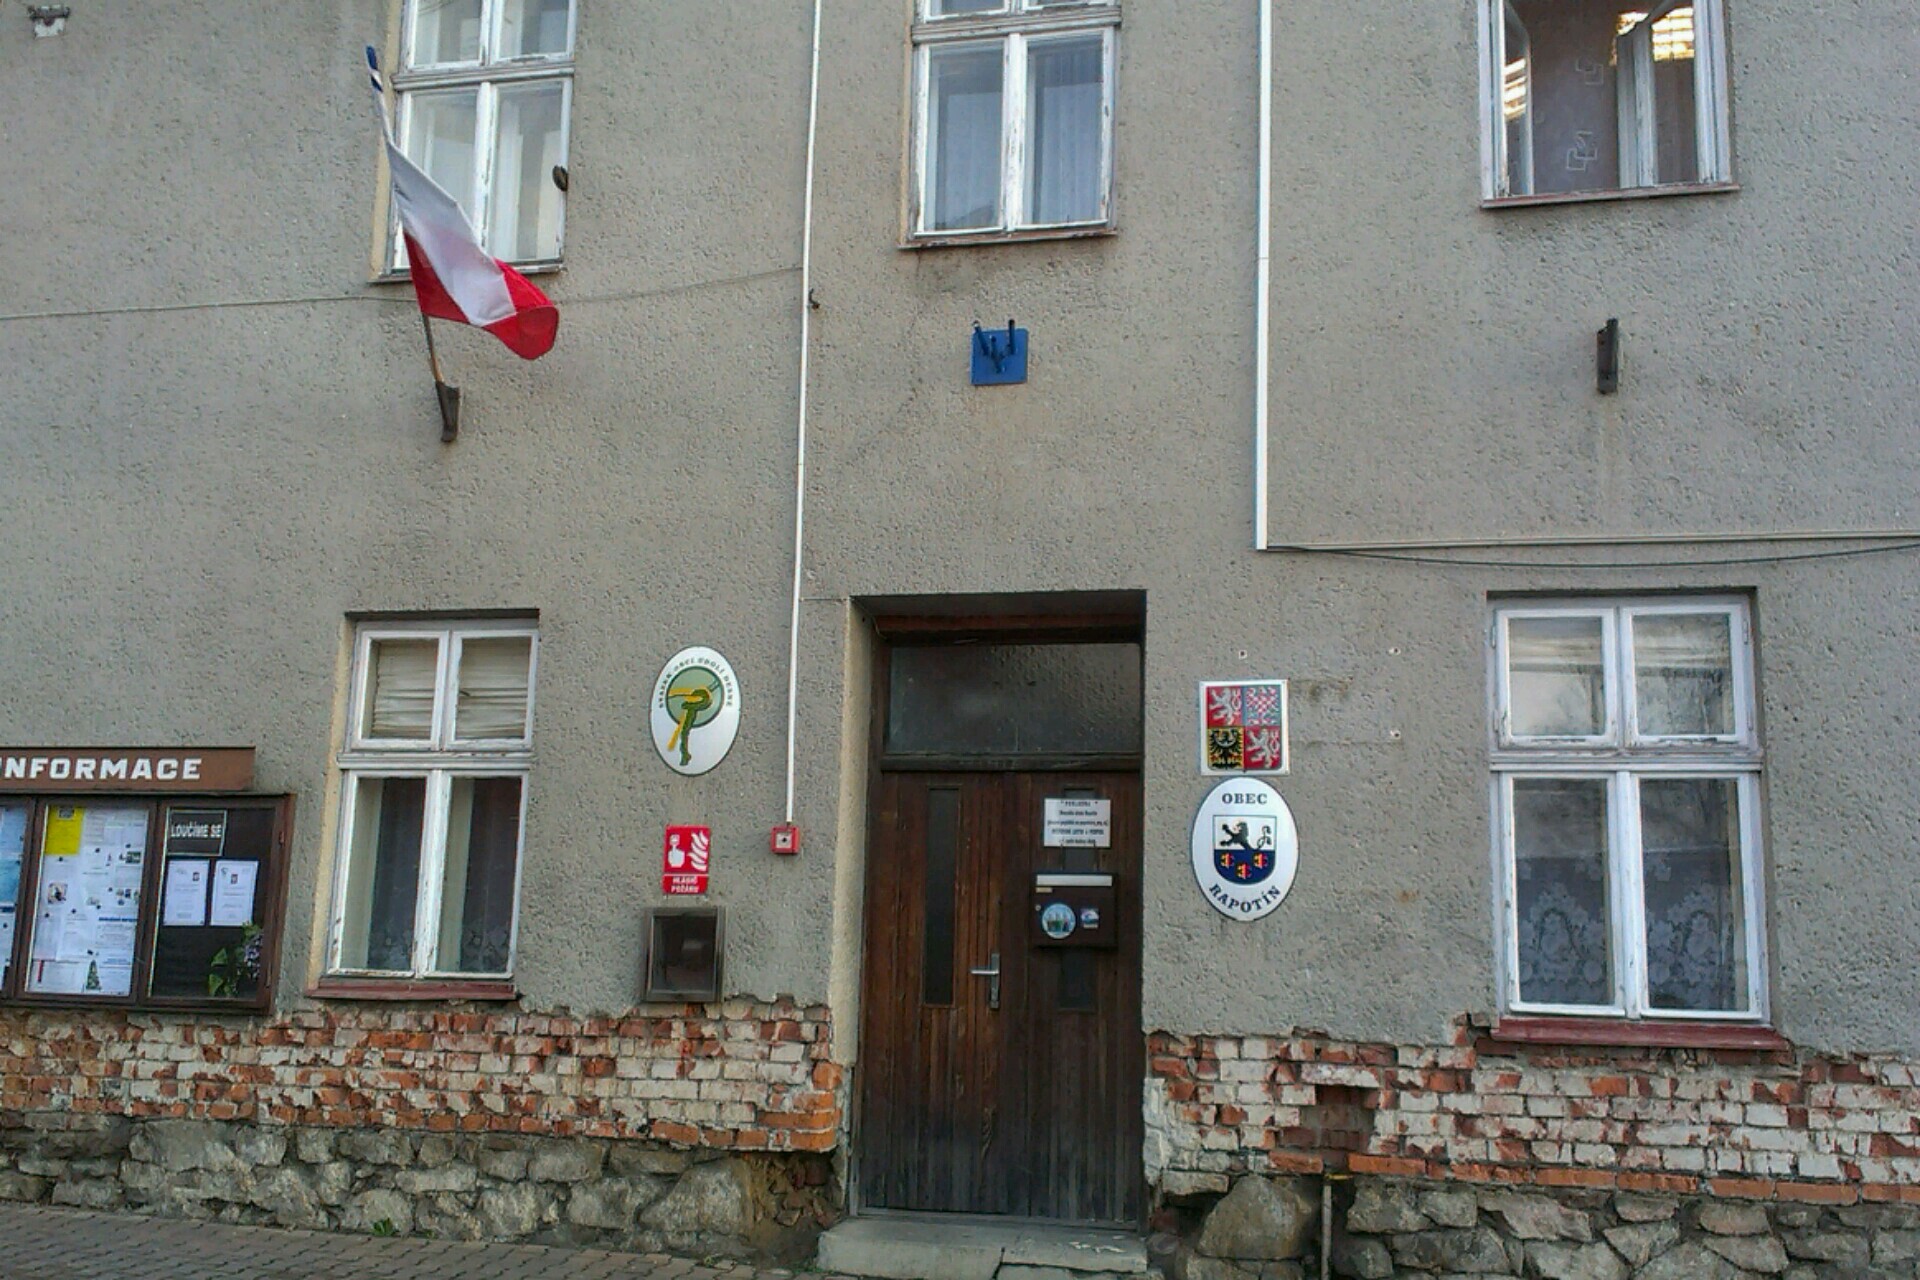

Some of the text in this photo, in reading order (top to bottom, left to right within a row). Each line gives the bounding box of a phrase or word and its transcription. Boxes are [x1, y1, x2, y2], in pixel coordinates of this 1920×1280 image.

[0, 757, 202, 780] NFORMACE
[1221, 792, 1268, 805] OBEC
[210, 824, 222, 838] SE
[1208, 883, 1282, 914] RAPOTÍN
